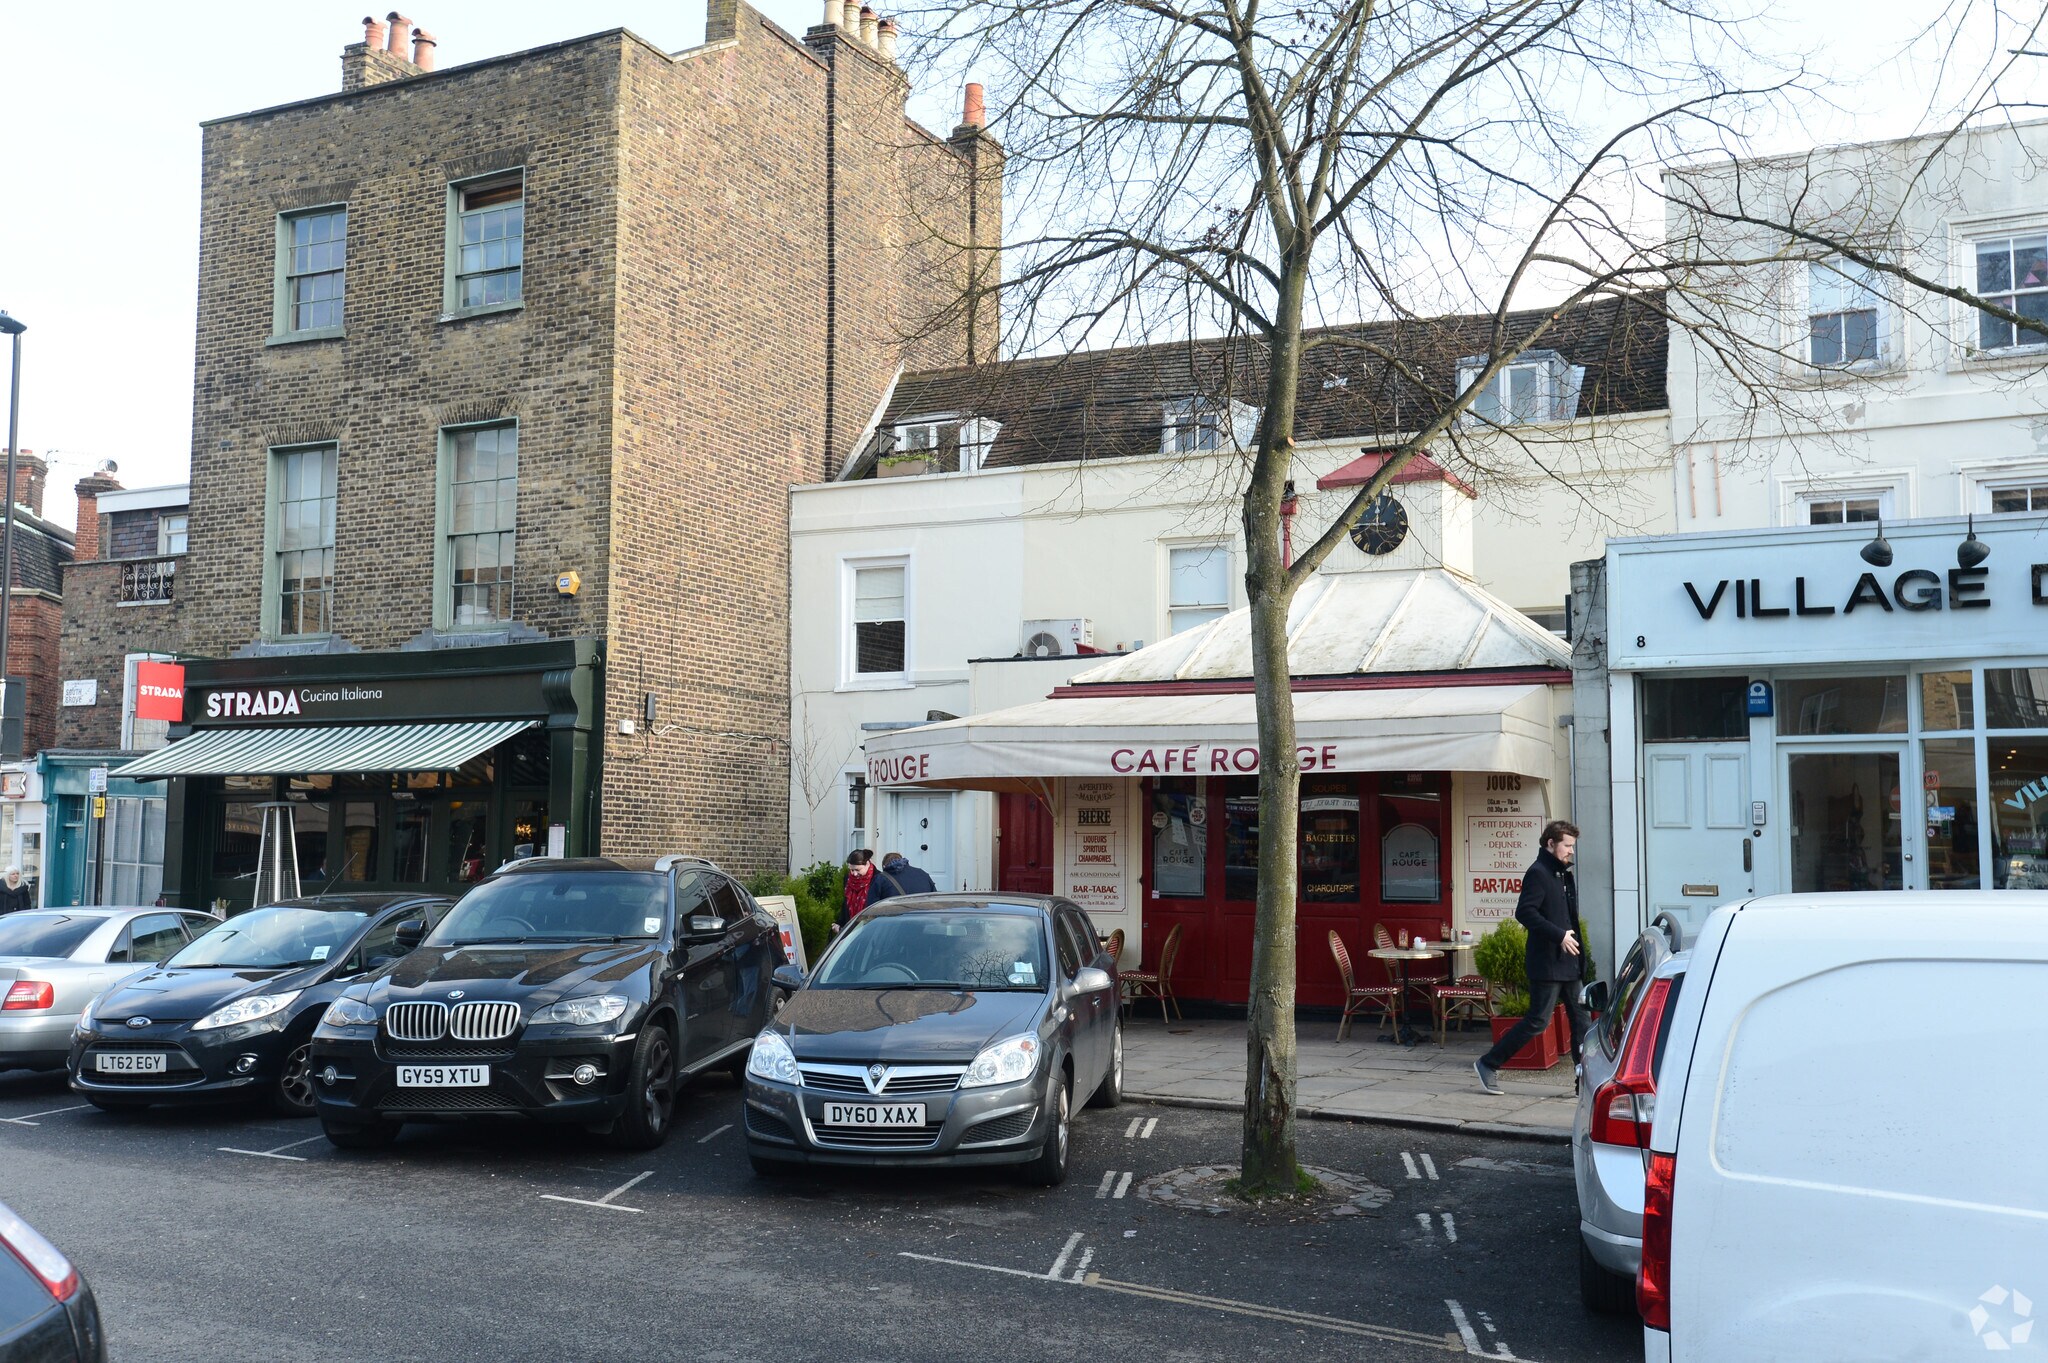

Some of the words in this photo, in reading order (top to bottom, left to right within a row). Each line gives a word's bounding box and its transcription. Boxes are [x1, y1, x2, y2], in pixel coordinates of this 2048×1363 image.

[1683, 566, 1990, 620] VILLAGE
[1636, 635, 1646, 648] 8
[140, 685, 182, 699] STRADA
[206, 690, 300, 718] STRADA
[301, 689, 338, 703] Cucina
[341, 686, 383, 700] Italiana
[1111, 745, 1200, 773] CAFÉ
[1211, 745, 1337, 772] ROGE
[874, 754, 929, 783] ROUGE
[1486, 774, 1521, 791] JOURS
[1306, 834, 1355, 843] BAGUETTES
[1495, 830, 1514, 838] CAFÉ
[1163, 856, 1194, 864] ROUGE
[1307, 884, 1355, 893] CHARCUTERIE
[101, 1056, 132, 1070] LT62
[136, 1056, 161, 1070] EGY
[402, 1068, 443, 1084] GY59
[449, 1068, 481, 1084] XTU
[832, 1106, 877, 1123] DY60
[883, 1107, 918, 1123] XAX
